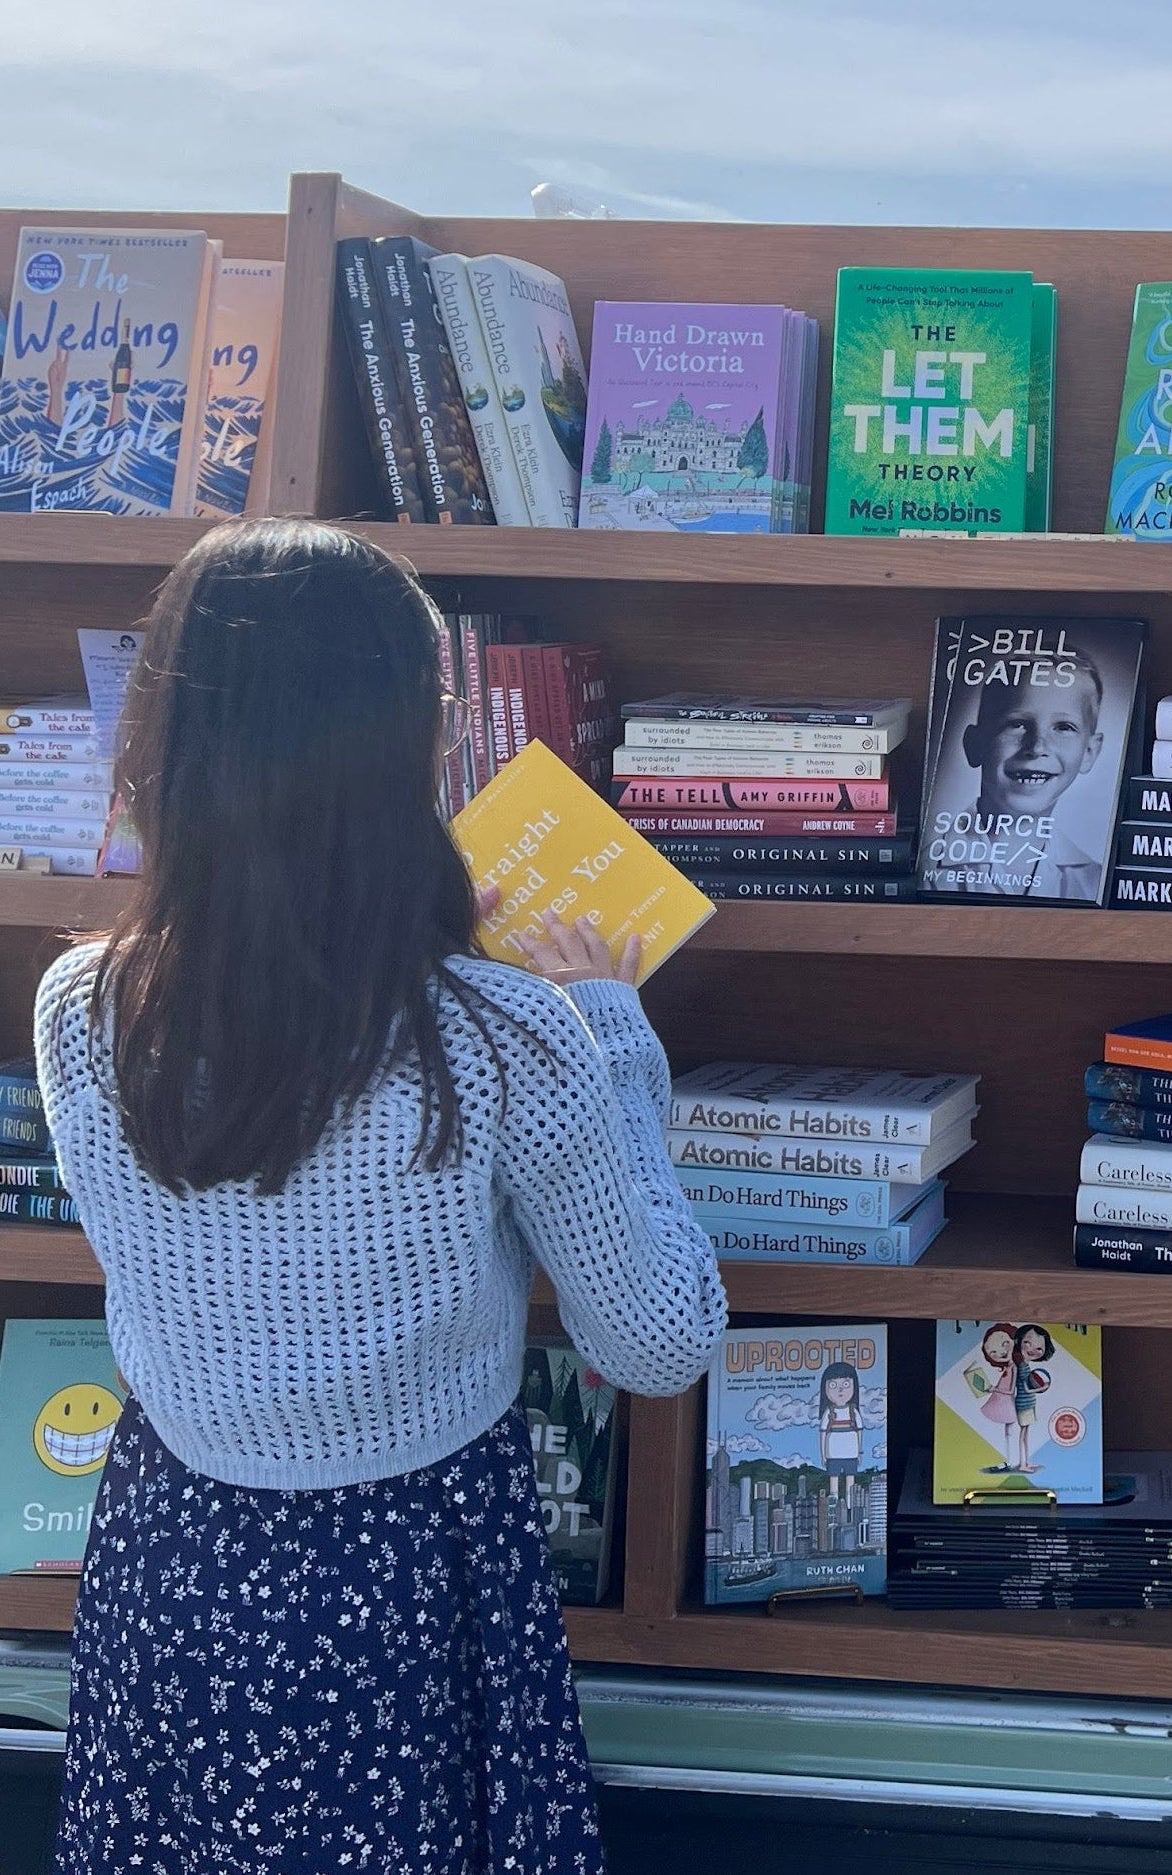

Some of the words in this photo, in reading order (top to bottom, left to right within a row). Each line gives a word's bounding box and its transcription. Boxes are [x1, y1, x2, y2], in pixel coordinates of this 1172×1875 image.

[28, 269, 58, 278] JENNA
[77, 253, 129, 294] The
[345, 267, 358, 298] Haidt
[354, 255, 371, 308] Jonathan
[930, 285, 947, 294] Tool
[359, 320, 374, 348] The
[437, 270, 473, 373] Abundance
[474, 271, 510, 375] Abundance
[911, 325, 956, 342] THE
[614, 323, 677, 344] Hand
[686, 325, 765, 347] Drawn
[632, 347, 745, 373] Victoria
[366, 353, 386, 415] Anxious
[881, 349, 986, 400] LET
[55, 391, 169, 475] People
[843, 404, 1014, 457] THEM
[379, 417, 403, 506] Generation
[879, 463, 976, 482] THEORY
[31, 477, 87, 512] Espach
[849, 499, 894, 520] Mel
[901, 500, 1001, 523] Robbins
[466, 632, 476, 658] FIVE
[469, 663, 480, 700] LITTLE
[964, 659, 1077, 687] GATES
[40, 713, 68, 722] Tales
[48, 723, 65, 732] the
[472, 705, 485, 755] INDIANS
[491, 687, 509, 760] INDIGENOUS
[643, 727, 691, 735] surrounded
[648, 737, 657, 745] by
[630, 788, 665, 803] THE
[676, 789, 721, 803] TELL
[741, 791, 767, 802] AMY
[778, 791, 835, 803] GRIFFIN
[629, 818, 656, 830] CRISIS
[658, 819, 670, 830] OF
[671, 818, 713, 831] CANADIAN
[714, 819, 765, 831] DEMOCRACY
[802, 820, 831, 831] ANDREW
[832, 820, 856, 831] COYNE
[934, 812, 1055, 838] SOURCE
[571, 840, 626, 884] You
[733, 848, 828, 862] ORIGINAL
[838, 850, 869, 861] SIN
[738, 883, 837, 896] ORIGINAL
[844, 883, 875, 895] SIN
[923, 870, 942, 882] MY
[946, 871, 1042, 887] BEGINNINGS
[1117, 879, 1172, 903] MARK
[3, 1118, 37, 1142] FRIENDS
[688, 1104, 781, 1130] Atomic
[789, 1110, 871, 1137] Habits
[882, 1114, 890, 1139] James
[891, 1117, 899, 1137] Clear
[680, 1140, 772, 1168] Atomic
[781, 1148, 862, 1175] Habits
[1097, 1161, 1172, 1183] Careless
[29, 1195, 55, 1220] THE
[708, 1185, 734, 1203] Do
[737, 1188, 783, 1207] Hard
[786, 1190, 848, 1216] Things
[724, 1231, 749, 1249] Do
[753, 1232, 799, 1252] Hard
[804, 1235, 866, 1261] Things
[1091, 1237, 1143, 1251] Jonathan
[1101, 1250, 1131, 1262] Haidt
[726, 1339, 876, 1373] UPROOTED
[806, 1566, 833, 1576] RUTH
[835, 1563, 865, 1575] CHAN
